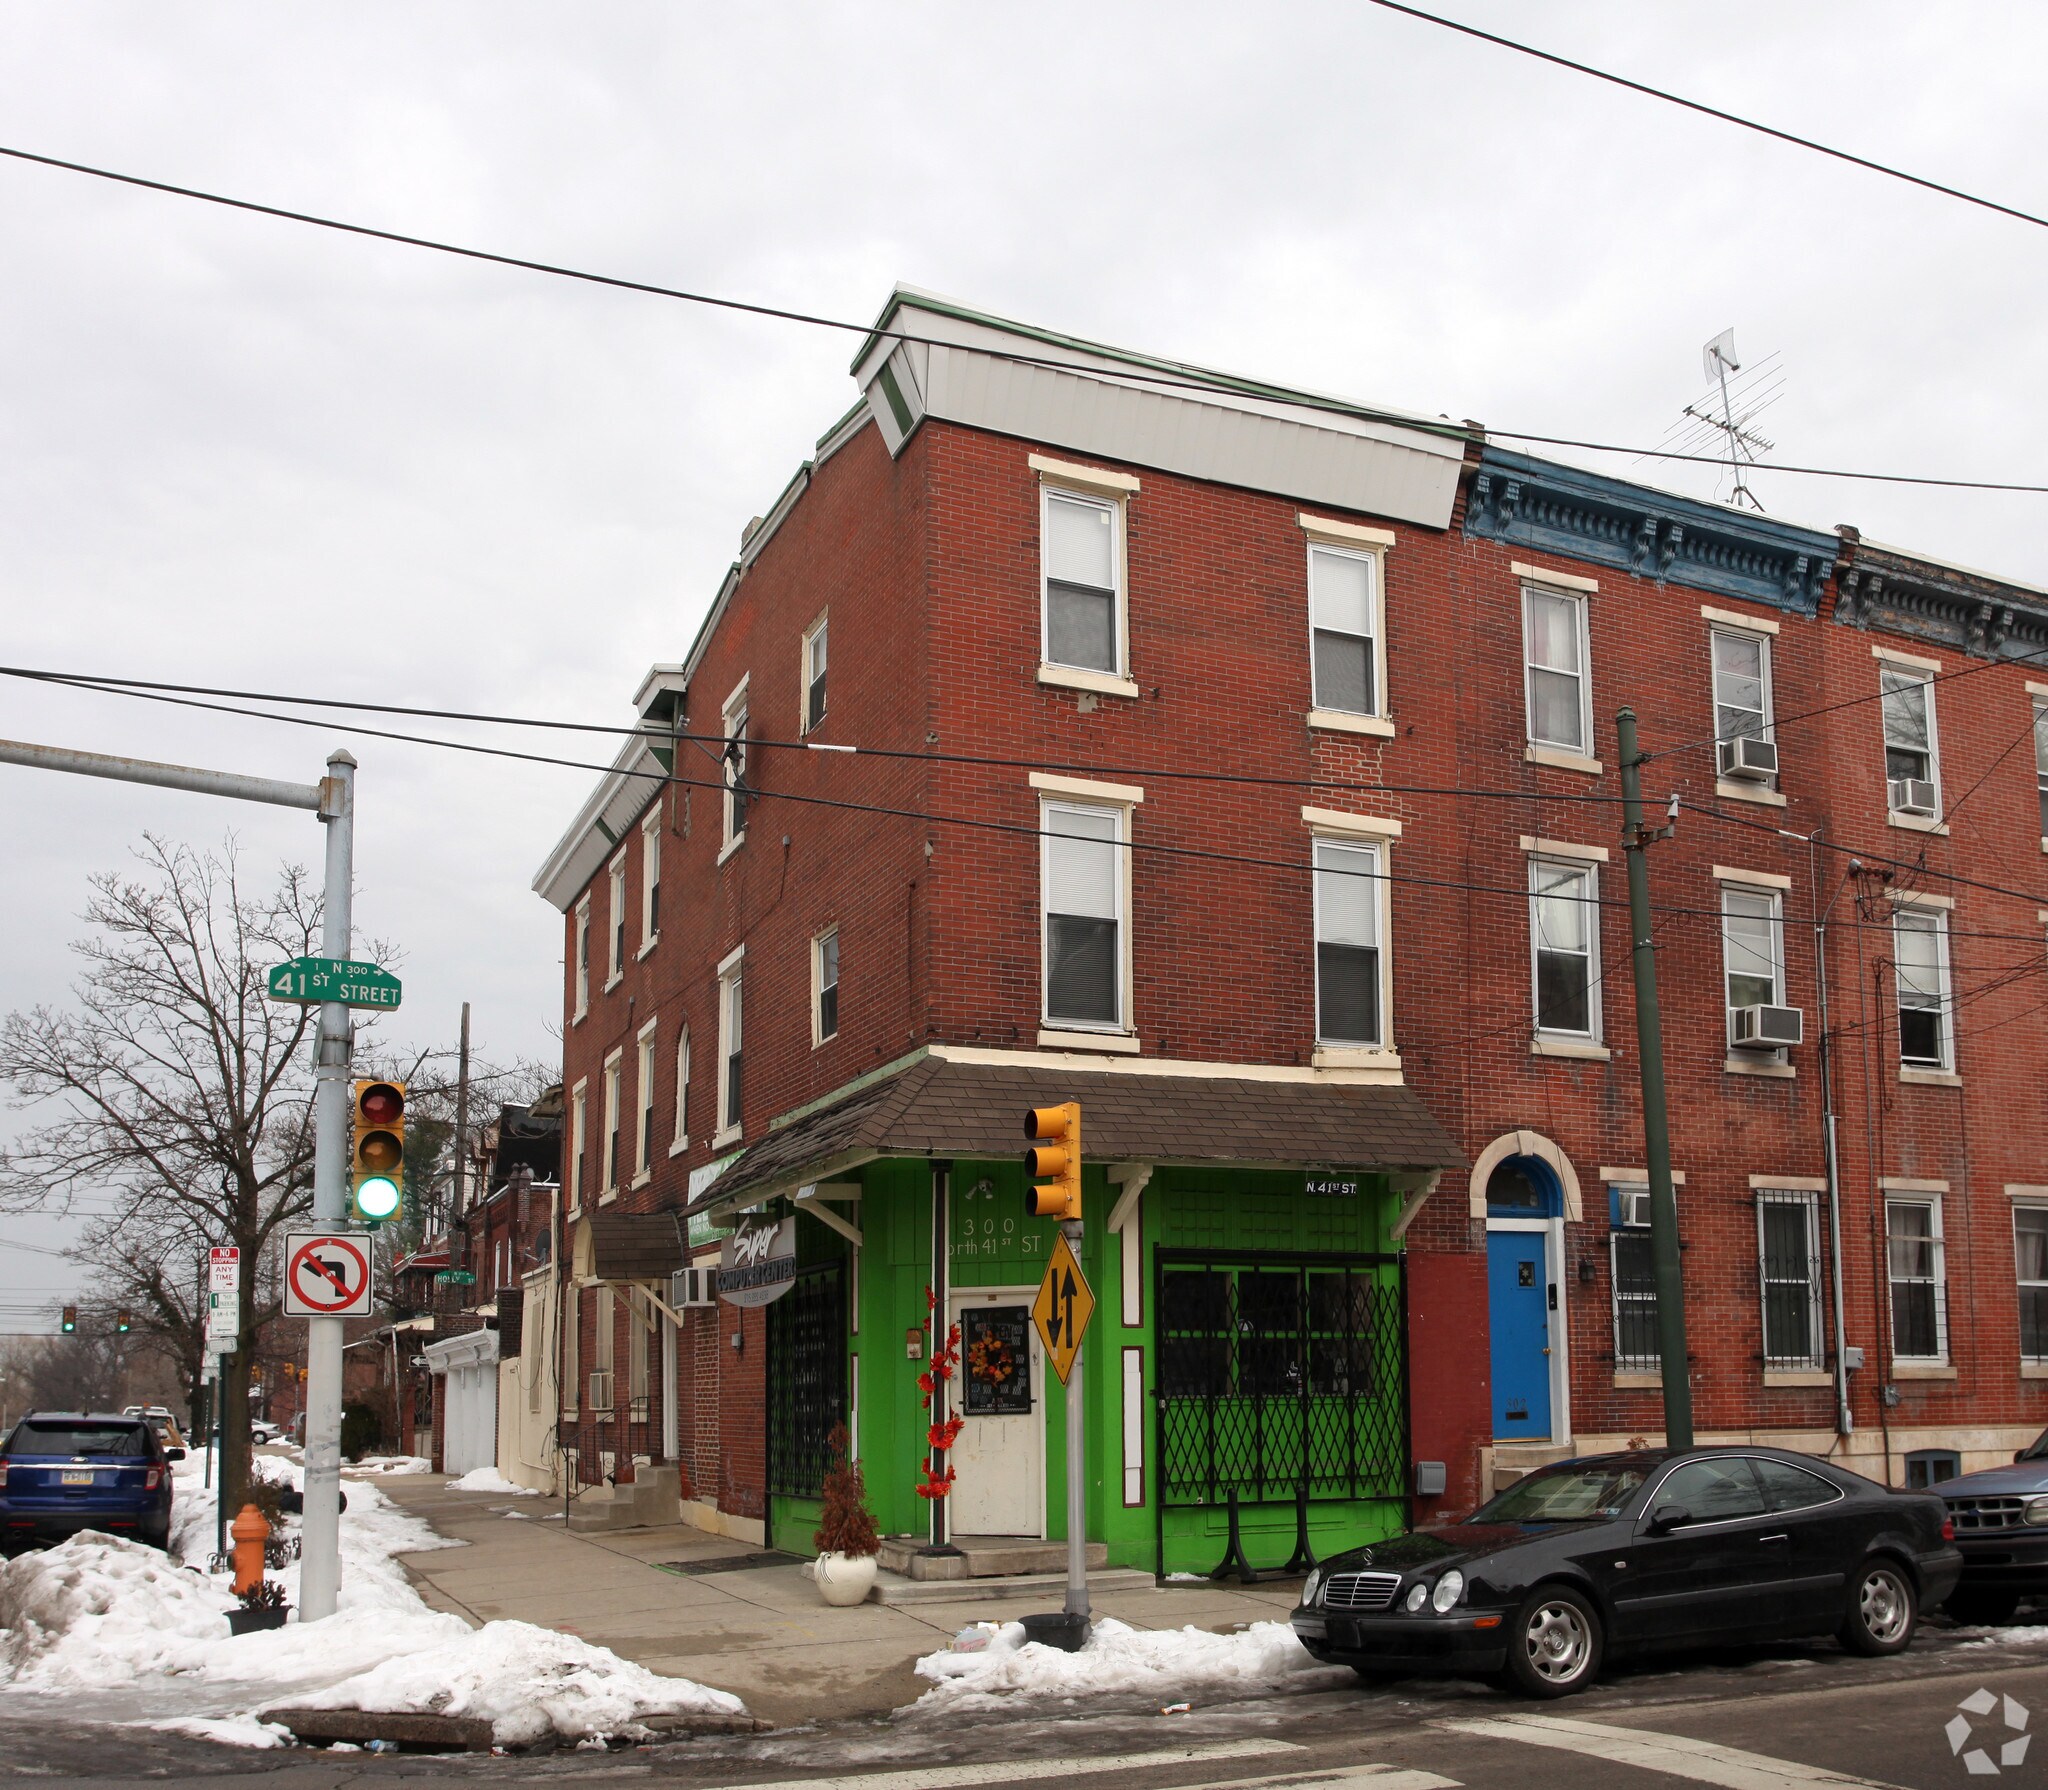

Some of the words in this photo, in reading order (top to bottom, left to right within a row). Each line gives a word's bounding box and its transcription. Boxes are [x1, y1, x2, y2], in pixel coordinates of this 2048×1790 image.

[333, 962, 342, 974] N
[346, 965, 368, 975] 300
[340, 983, 399, 1004] STREET
[1341, 1183, 1357, 1194] ST.
[219, 1248, 230, 1257] NO
[949, 1238, 978, 1256] orth
[1022, 1235, 1041, 1253] ST
[718, 1262, 762, 1292] COMPUTER
[761, 1256, 795, 1285] CENTER
